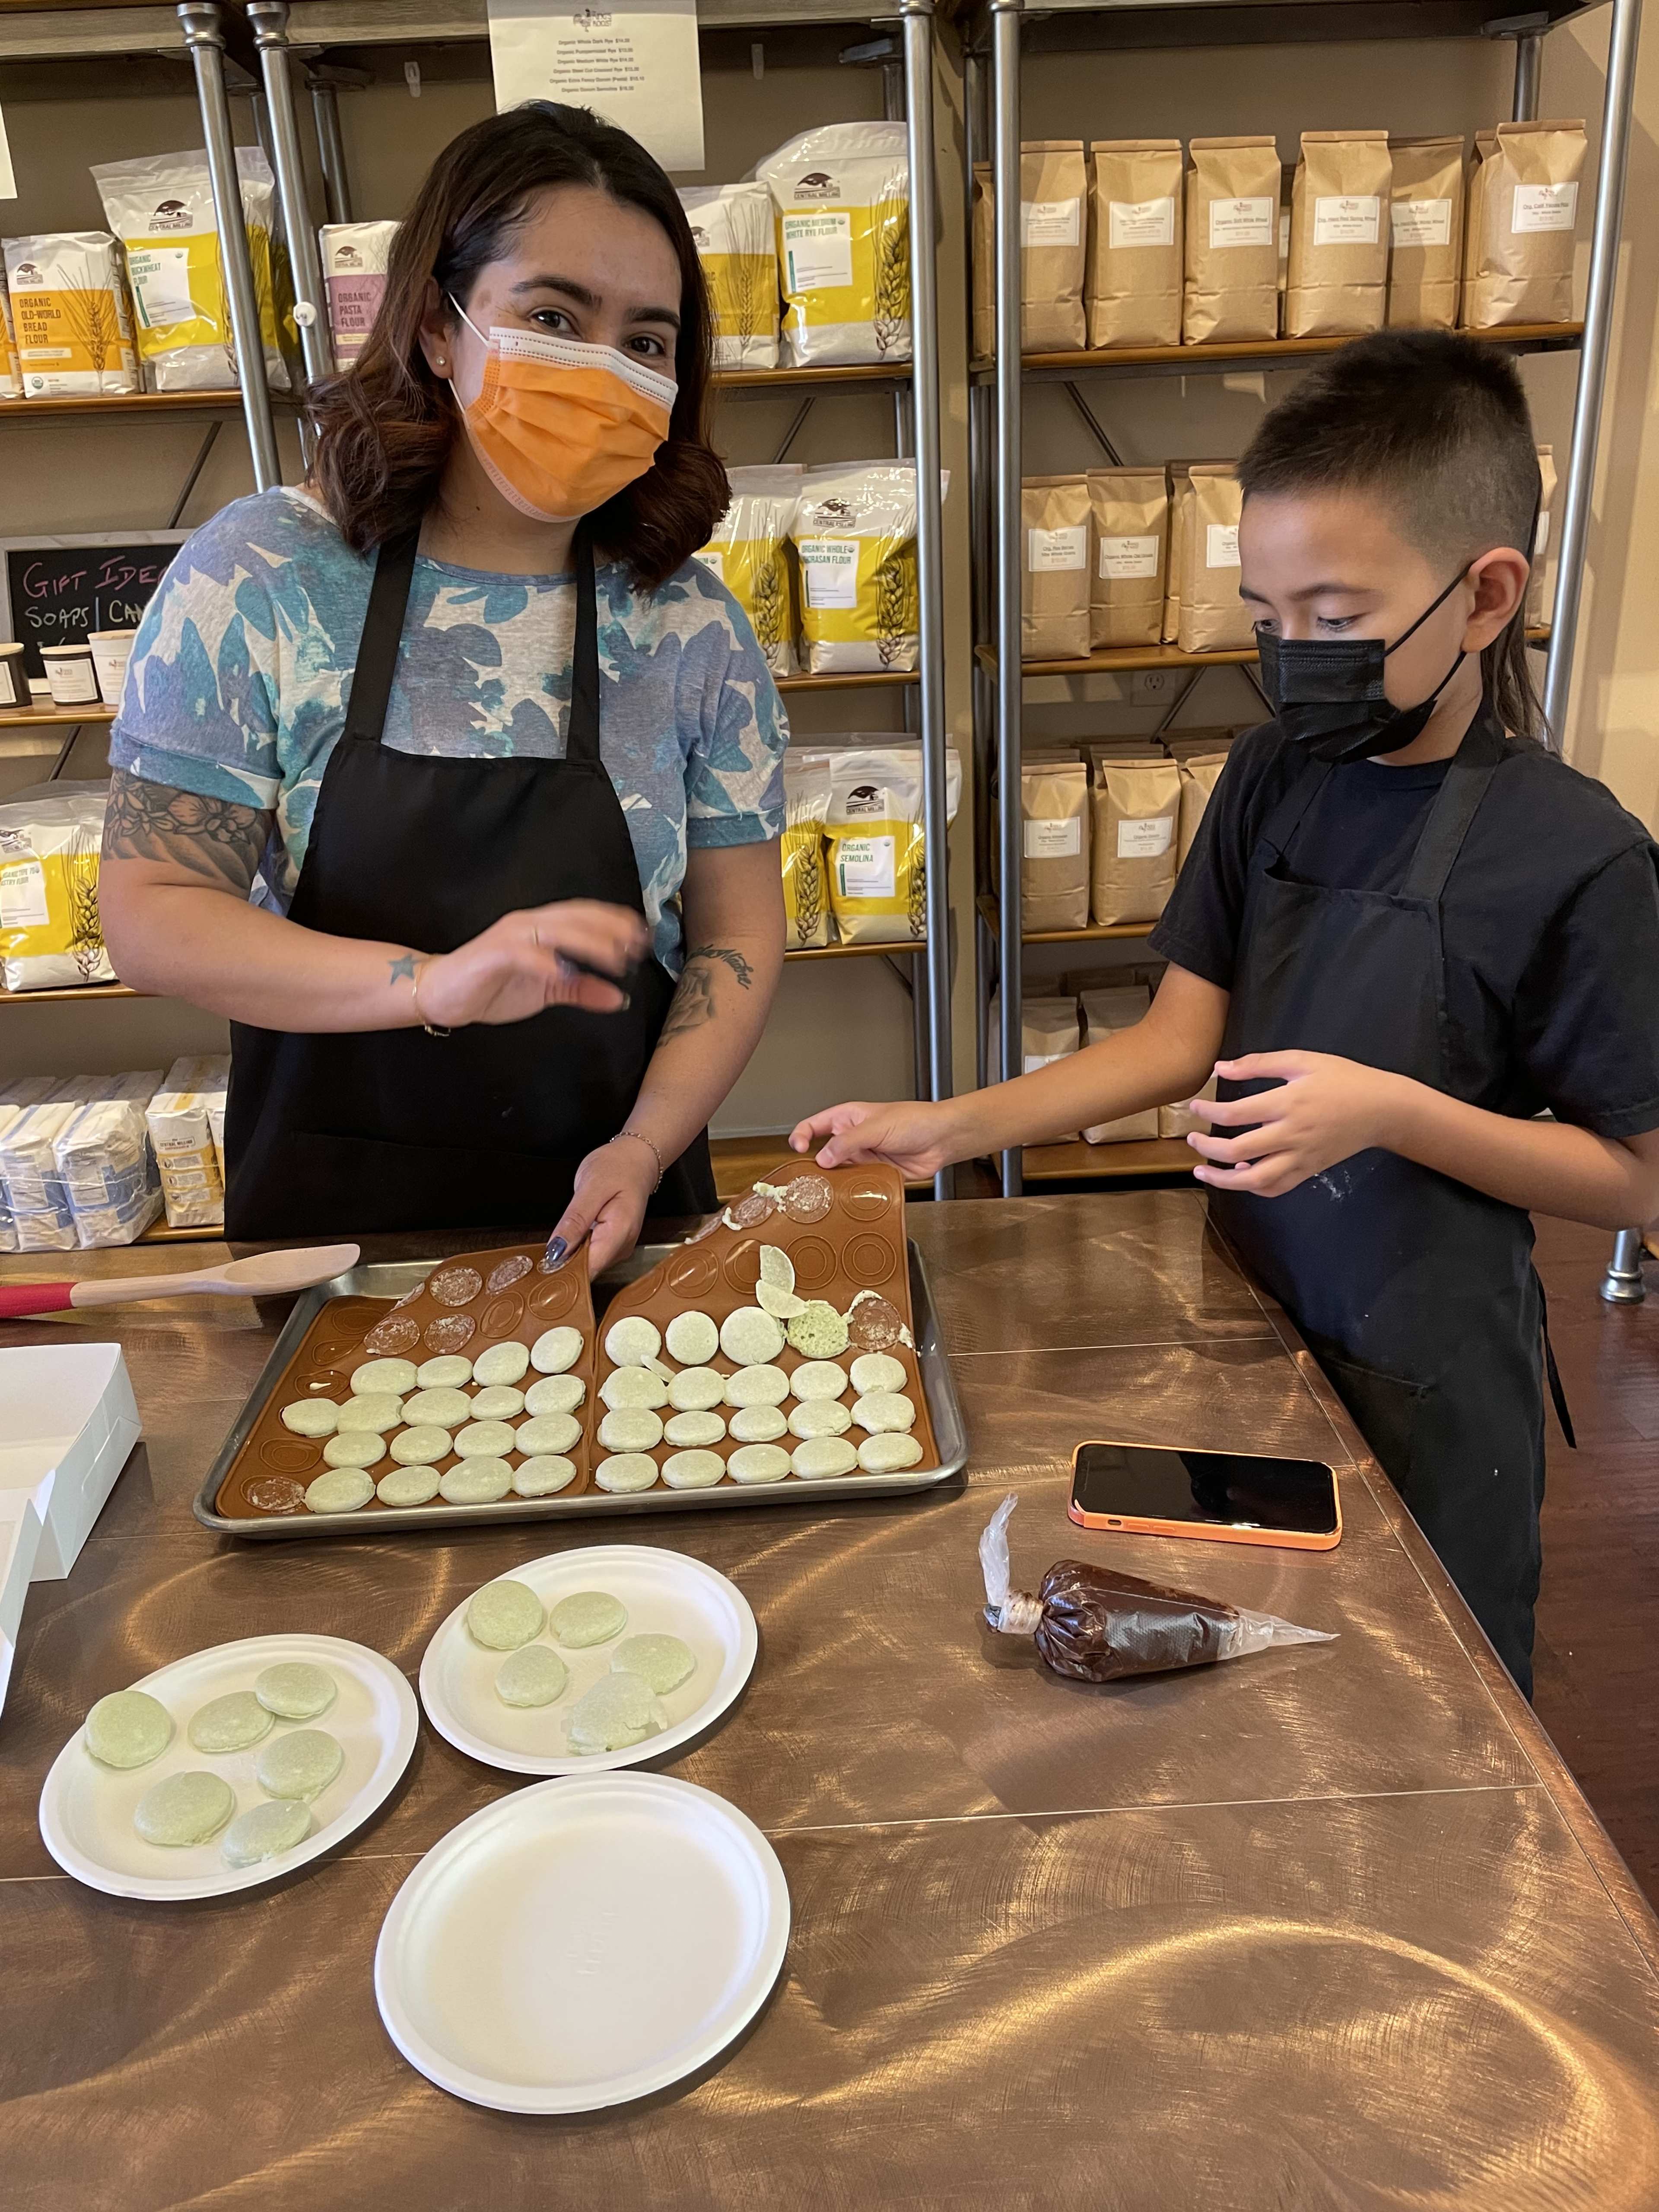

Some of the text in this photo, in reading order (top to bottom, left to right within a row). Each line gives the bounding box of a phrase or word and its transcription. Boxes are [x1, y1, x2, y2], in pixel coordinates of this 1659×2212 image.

[785, 218, 836, 230] ORGANIC MEDIUM
[786, 226, 837, 240] WHITE RYE FLOUR
[131, 263, 161, 276] BUCKWHEAT
[133, 275, 147, 285] FLOUR
[19, 297, 51, 308] ORGANIC
[338, 292, 372, 303] ORGANIC
[22, 309, 61, 320] OLD-WORLD
[340, 305, 362, 316] PASTA
[23, 322, 48, 332] BREAD
[341, 317, 365, 327] FLOUR
[25, 334, 48, 344] FLOUR
[801, 545, 847, 553] ORGANIC WHOLE
[832, 556, 851, 564] FLOUR
[23, 562, 87, 598] GIFT
[25, 606, 89, 629] SOAPS
[846, 806, 866, 814] CENTRAL
[842, 843, 871, 852] ORGANIC
[16, 877, 29, 885] FLOUR
